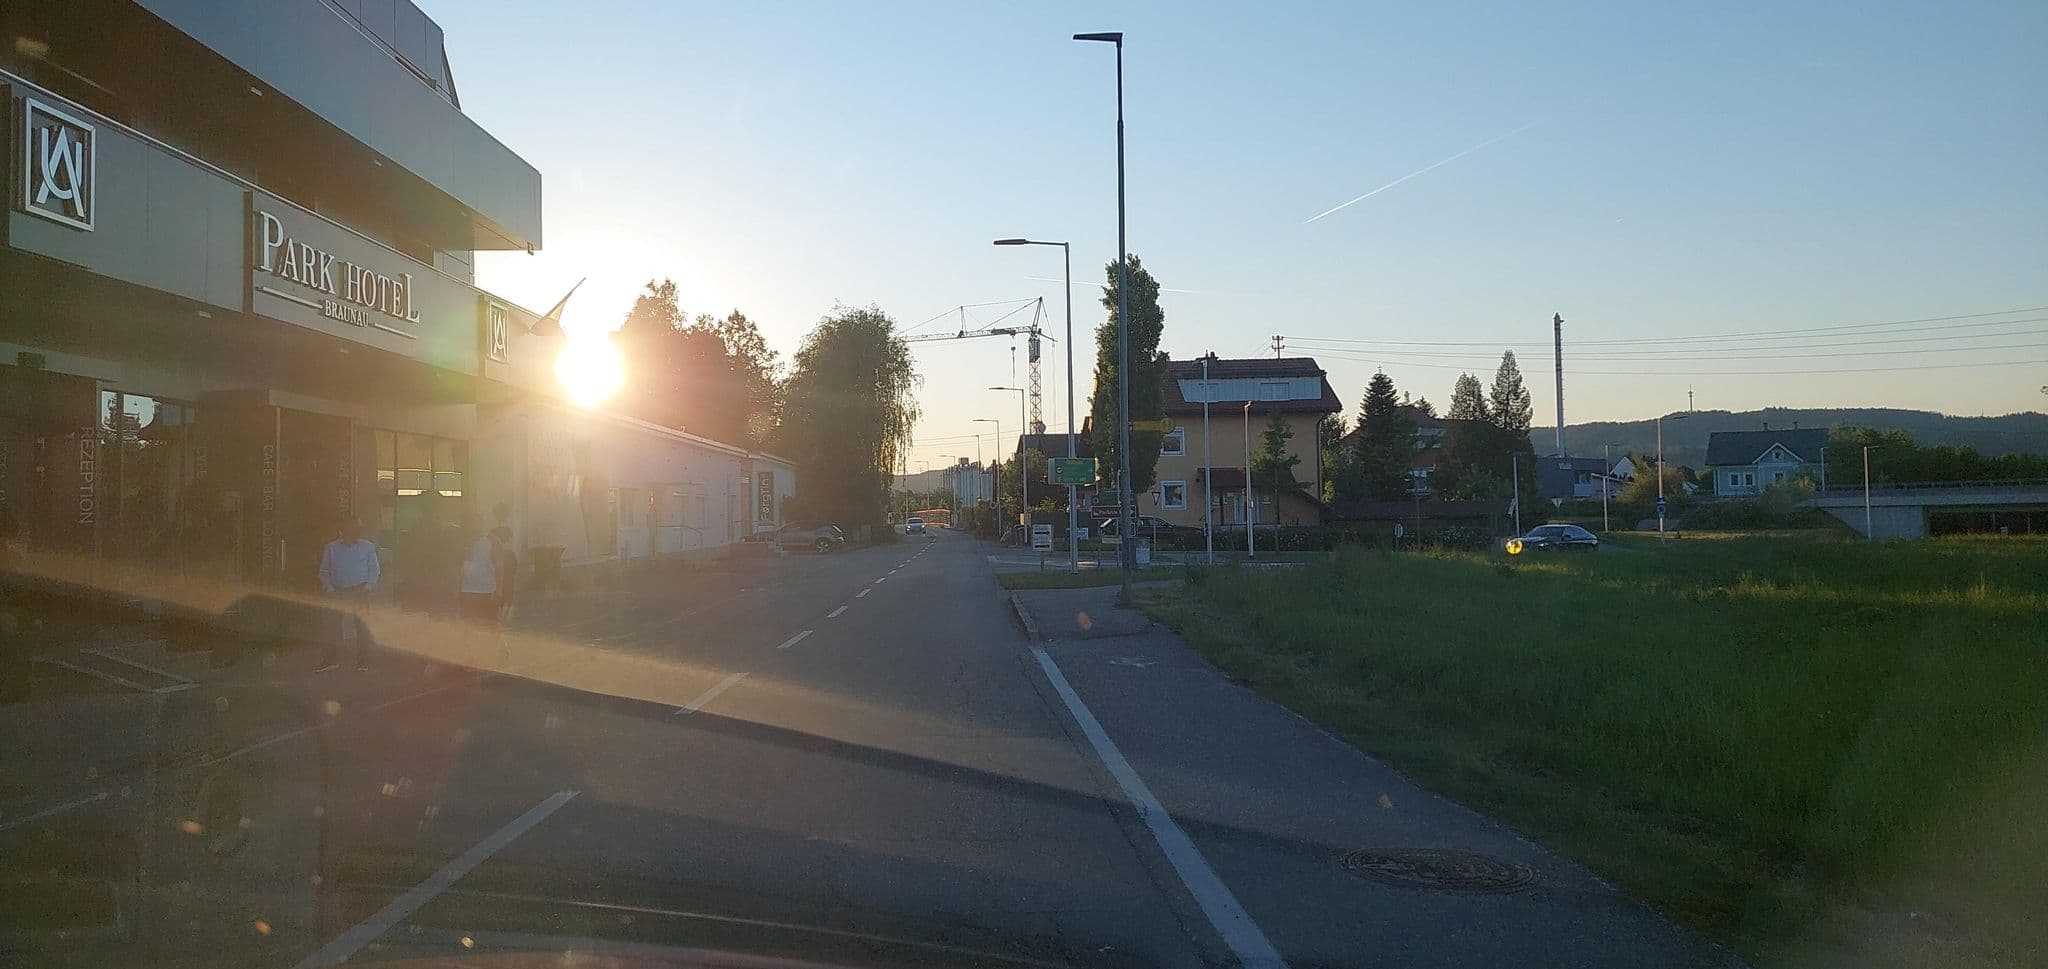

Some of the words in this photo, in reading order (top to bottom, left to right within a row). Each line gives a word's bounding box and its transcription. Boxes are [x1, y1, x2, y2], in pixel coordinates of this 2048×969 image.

[260, 210, 336, 295] PARK
[345, 261, 420, 323] HOTEL
[325, 299, 369, 328] BRAUNAU
[79, 426, 95, 524] REZEPTION
